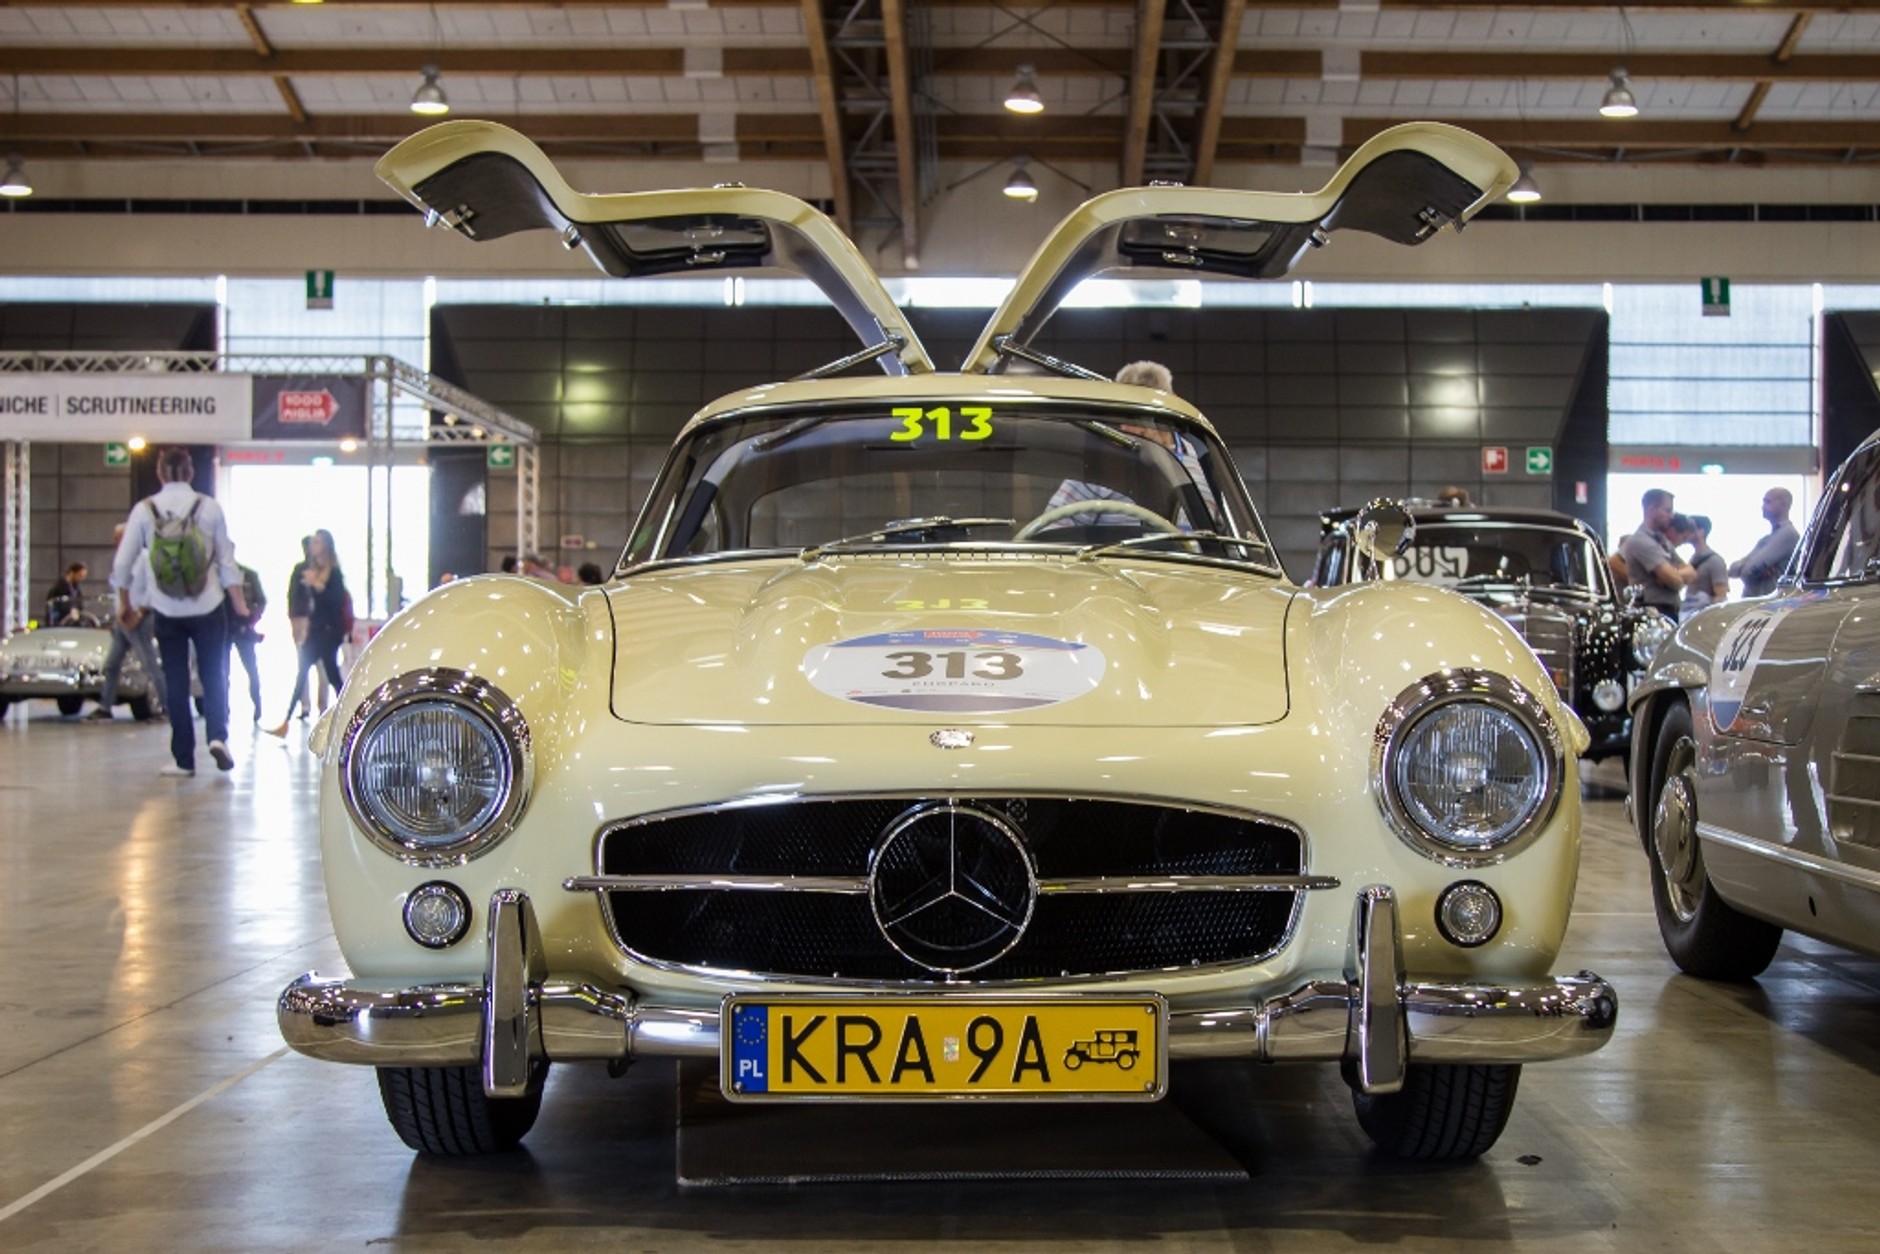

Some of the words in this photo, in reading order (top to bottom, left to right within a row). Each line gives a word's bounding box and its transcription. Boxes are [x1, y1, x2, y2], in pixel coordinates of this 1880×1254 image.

[67, 396, 216, 415] SCRUTINEERING
[890, 406, 993, 441] 313
[881, 652, 1024, 680] 313
[781, 1015, 935, 1084] KRA
[966, 1015, 1051, 1084] 9A
[739, 1059, 763, 1077] PL
